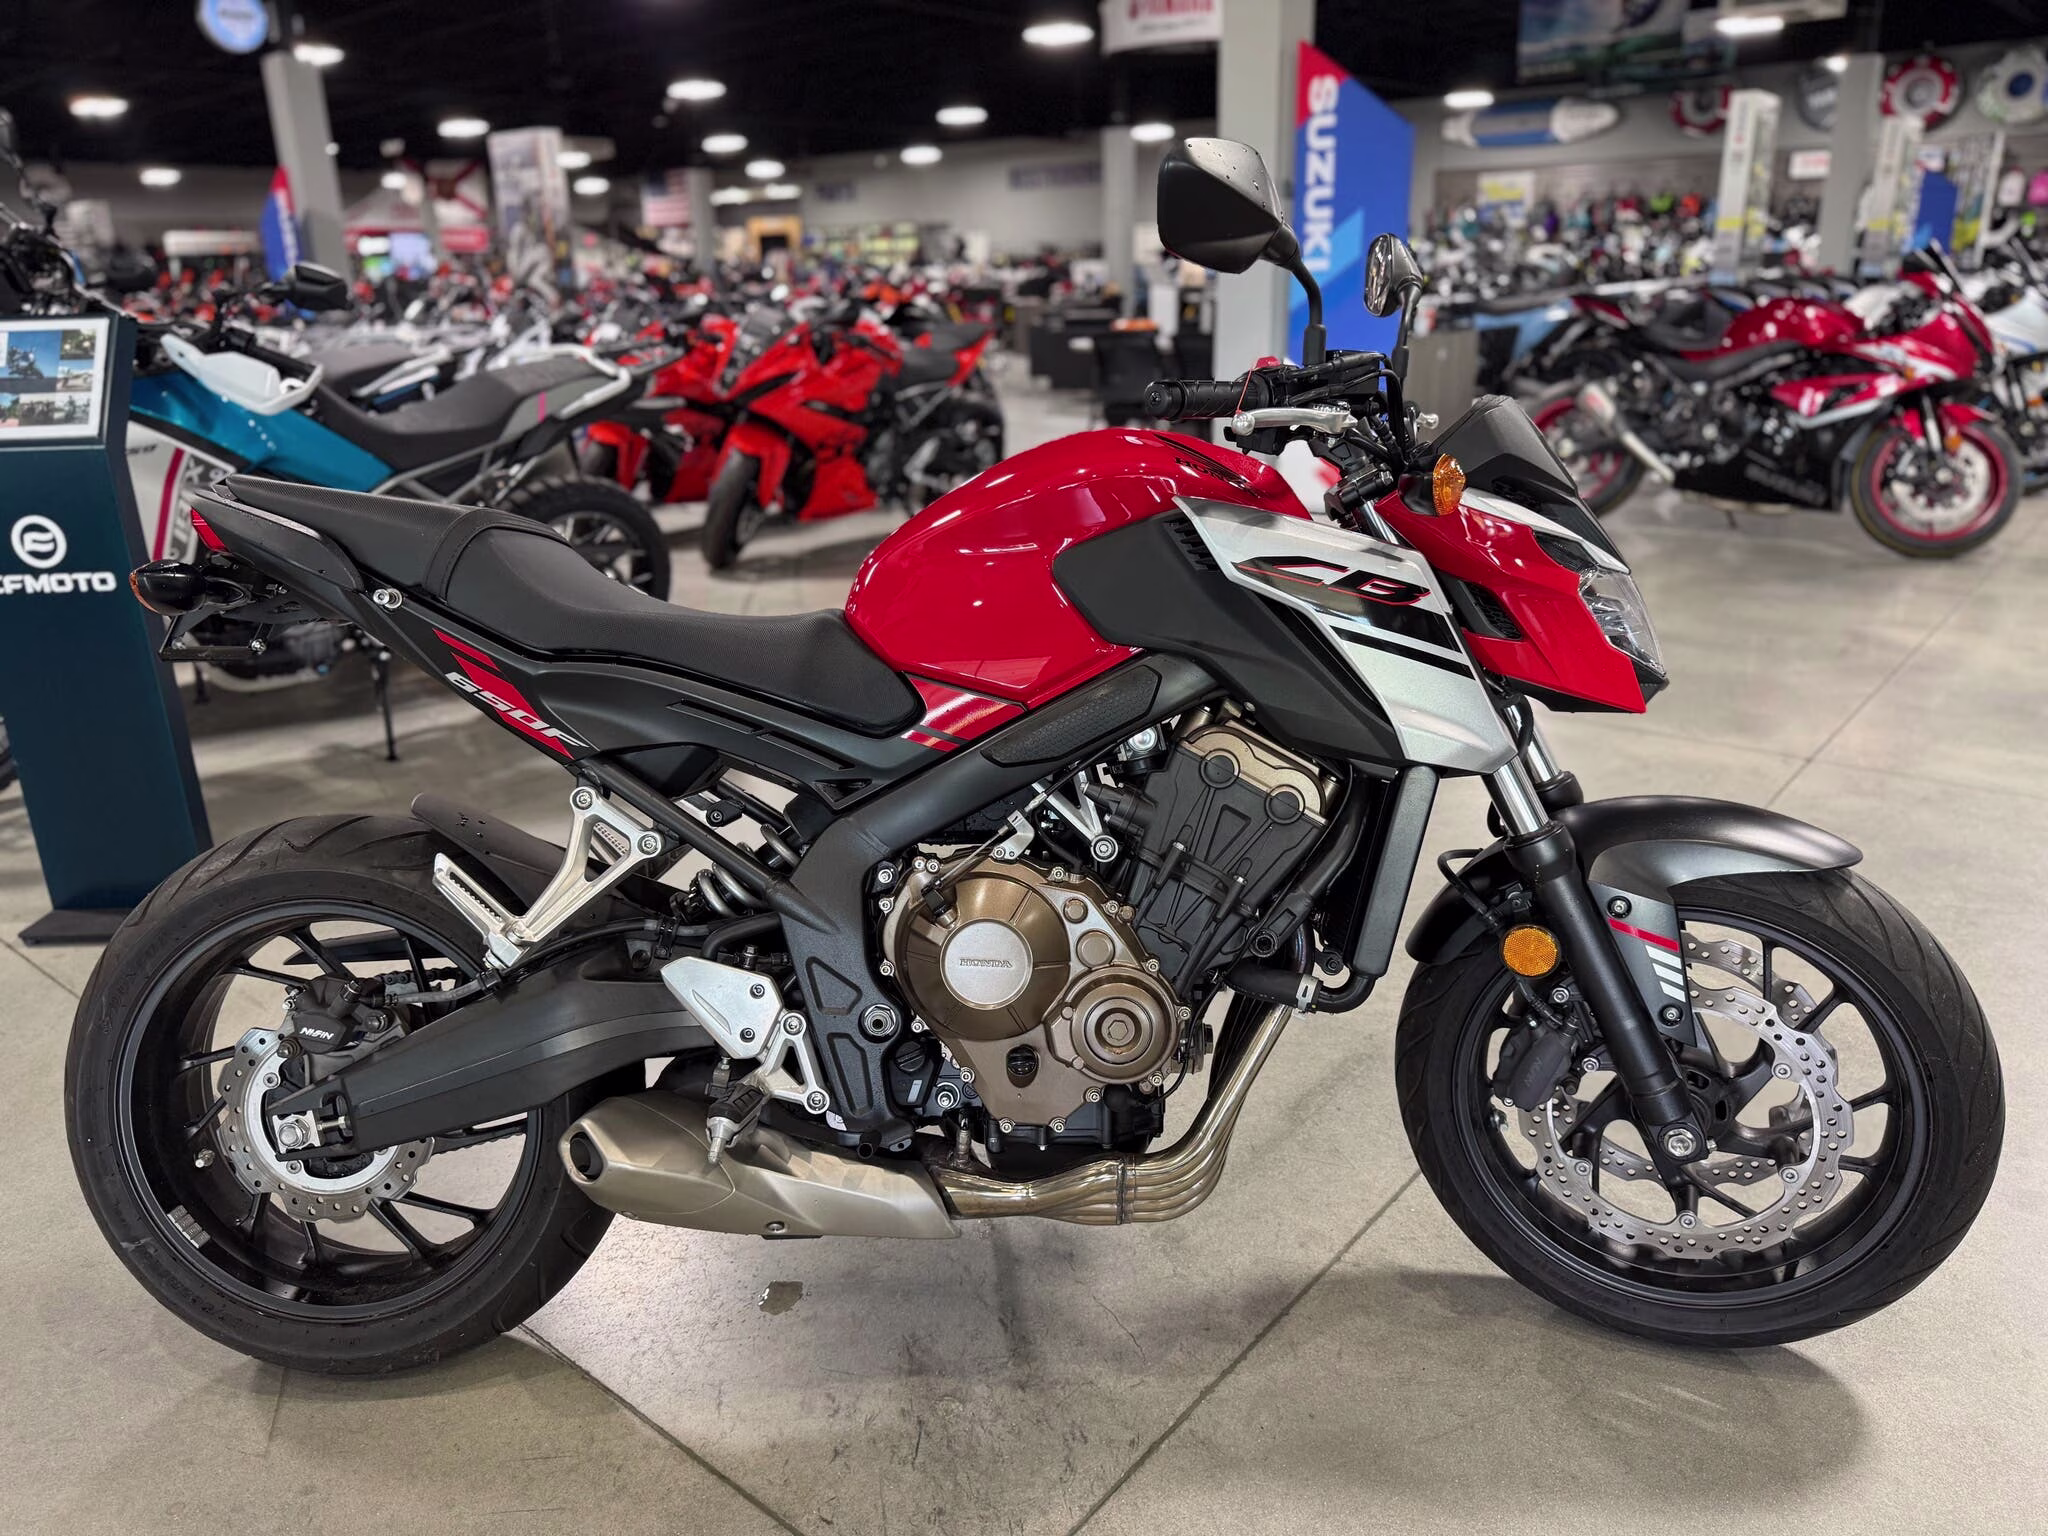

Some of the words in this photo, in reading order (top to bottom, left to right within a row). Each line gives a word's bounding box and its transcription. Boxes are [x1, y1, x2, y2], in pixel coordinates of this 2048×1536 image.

[1303, 74, 1339, 272] SUZUKI
[0, 571, 117, 595] FMOTO
[1231, 556, 1431, 606] CB
[445, 671, 590, 748] 650F
[959, 958, 1013, 969] HONDA
